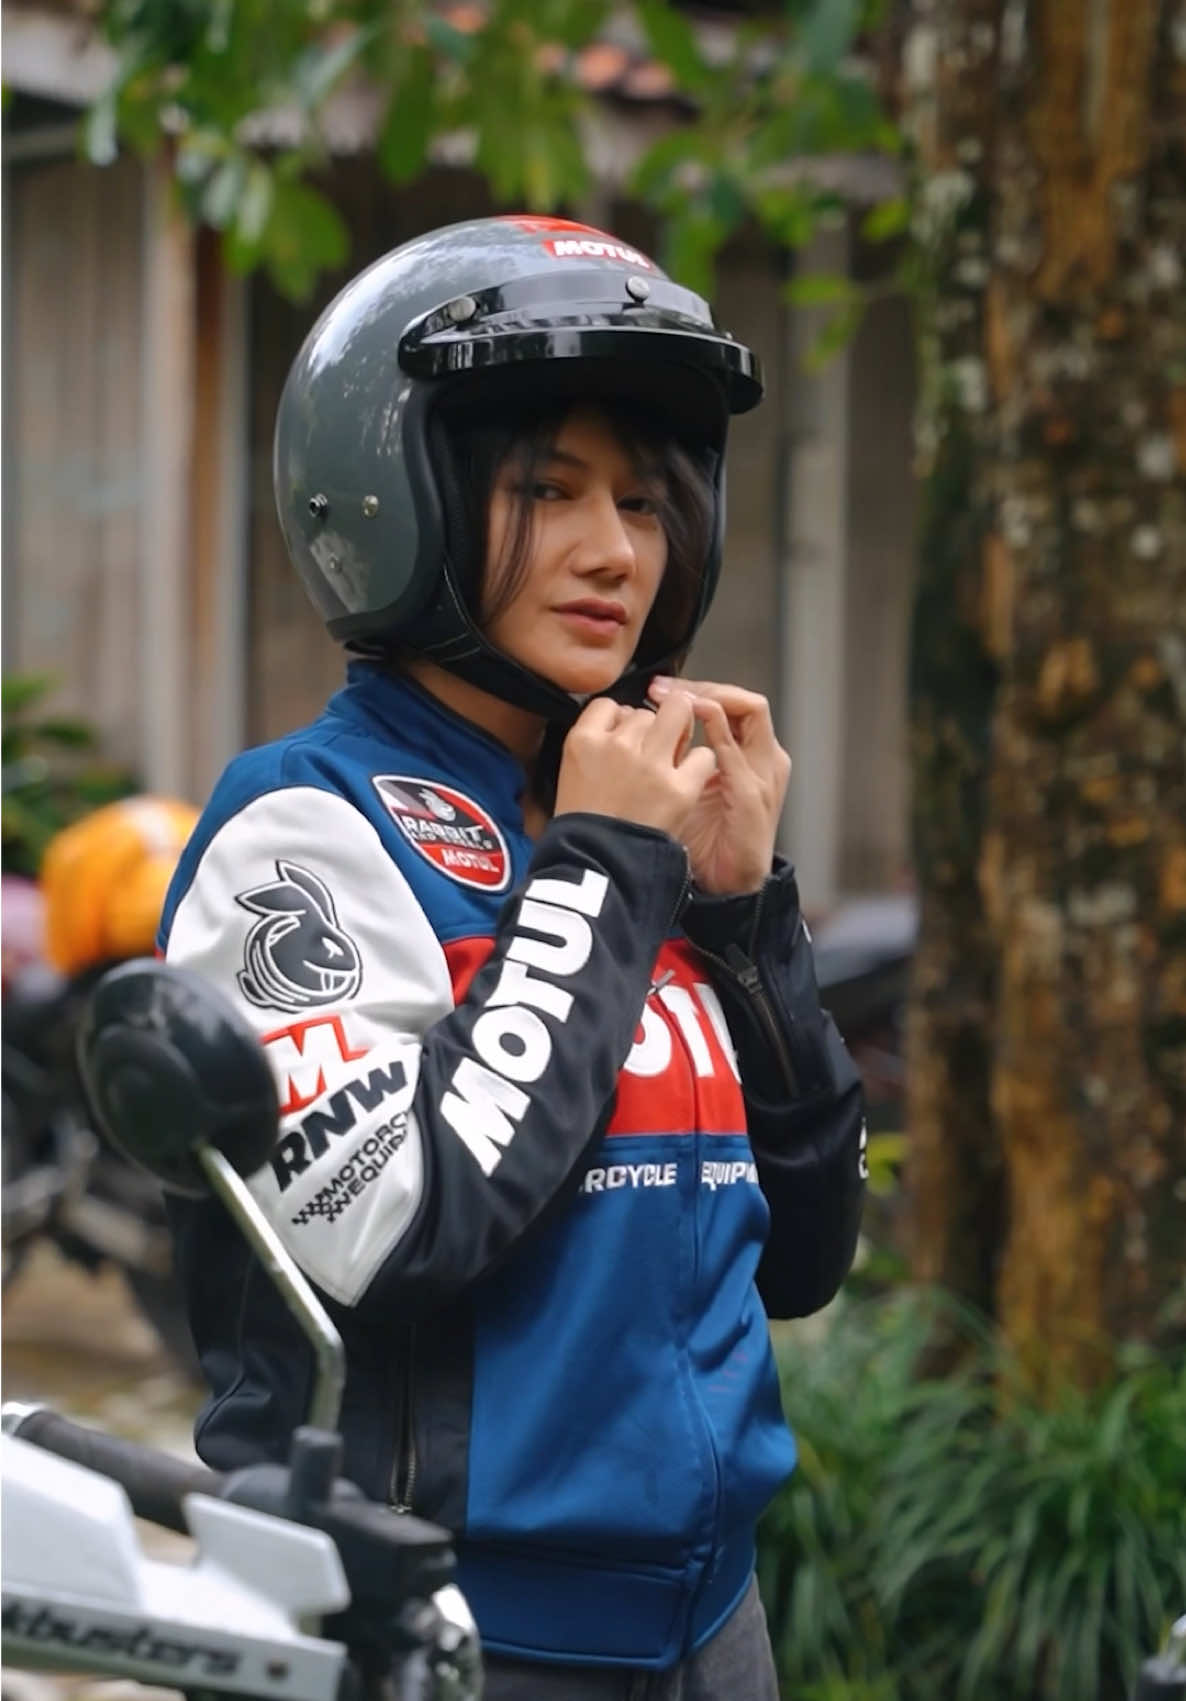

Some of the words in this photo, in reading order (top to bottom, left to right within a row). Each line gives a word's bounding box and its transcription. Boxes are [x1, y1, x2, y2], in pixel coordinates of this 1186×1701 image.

[401, 815, 483, 844] RABBIT
[441, 848, 500, 873] MOTUL
[440, 868, 609, 1177] MOTUL
[271, 1060, 408, 1193] RNW
[322, 1110, 410, 1201] MOTORC
[351, 1129, 408, 1197] EQUIP
[580, 1162, 677, 1193] RCYCLE
